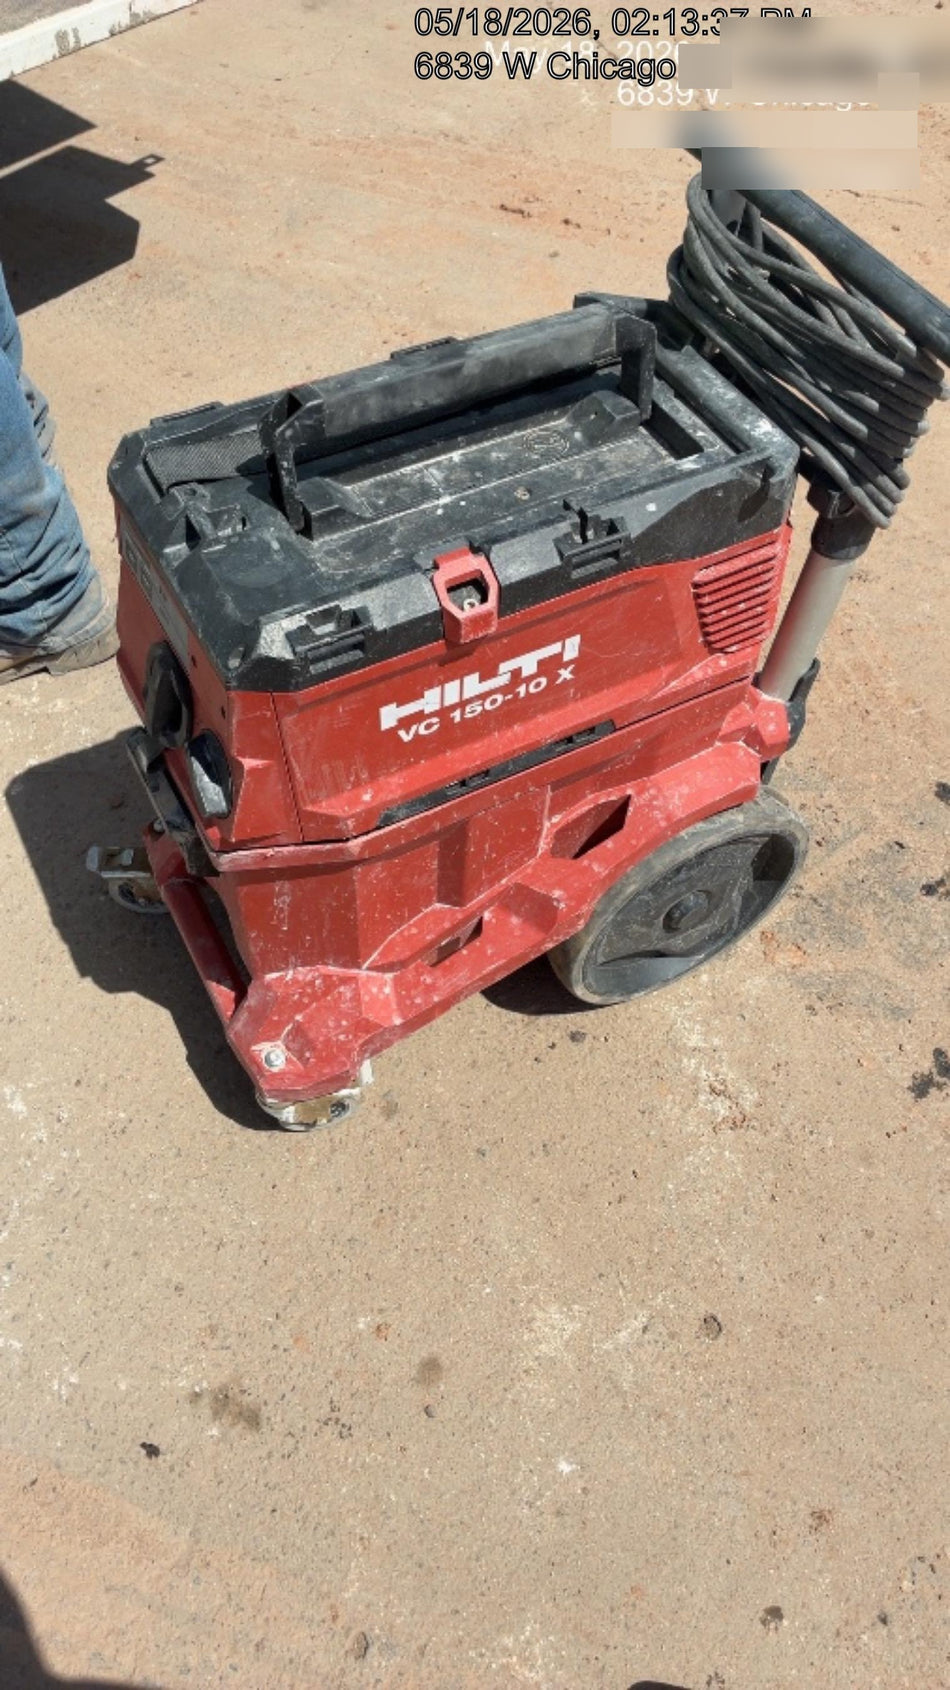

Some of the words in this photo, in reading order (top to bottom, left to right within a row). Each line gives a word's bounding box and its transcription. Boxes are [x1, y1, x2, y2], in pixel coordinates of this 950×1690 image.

[378, 634, 582, 731] HILTI
[397, 717, 441, 743] VC
[450, 677, 547, 724] 150-10
[555, 664, 576, 684] X
